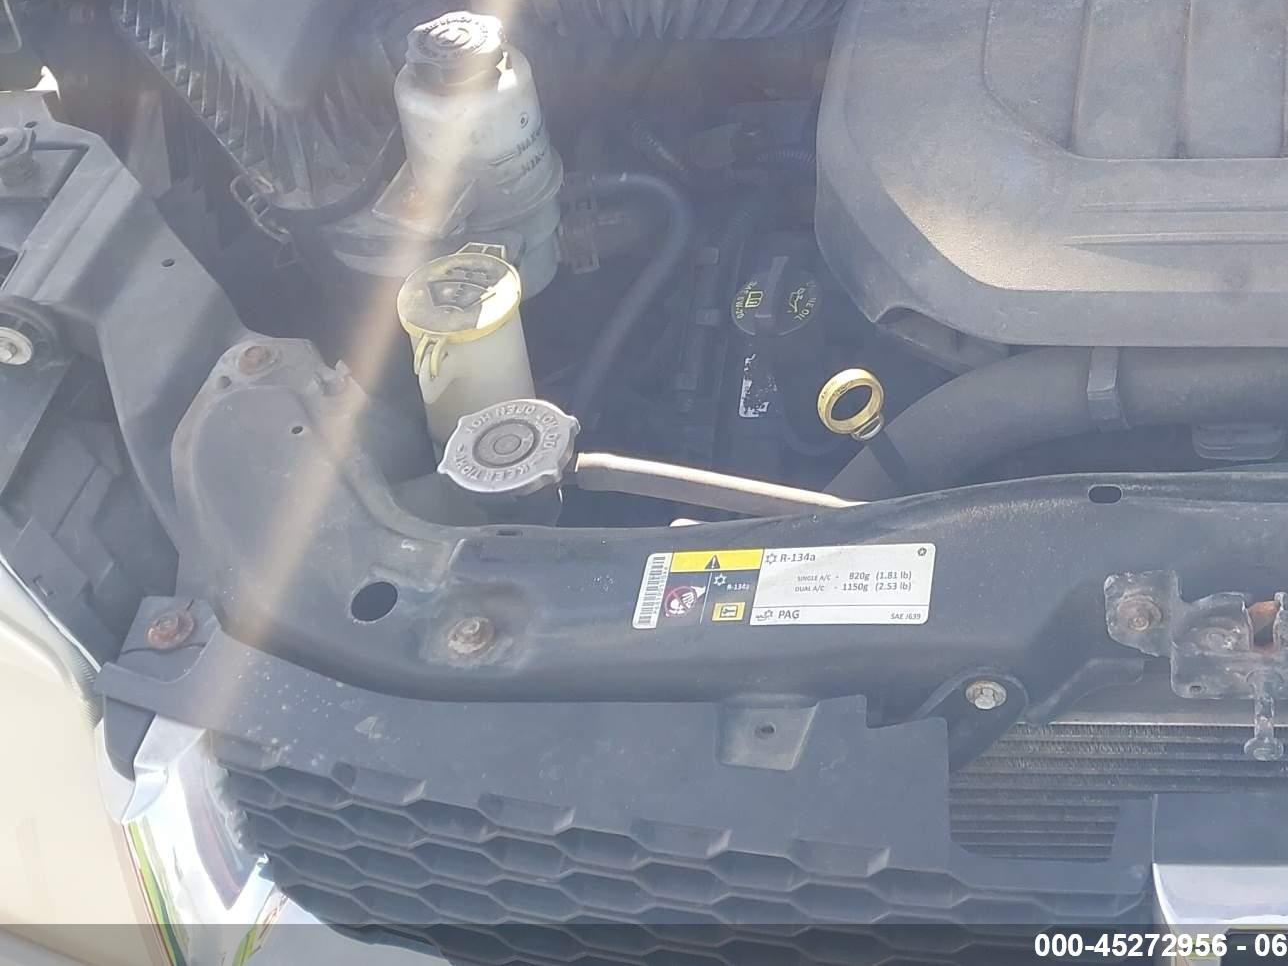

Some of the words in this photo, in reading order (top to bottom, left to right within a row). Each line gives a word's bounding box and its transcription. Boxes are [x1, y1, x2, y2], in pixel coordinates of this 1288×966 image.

[779, 552, 816, 563] R-134a
[818, 573, 832, 582] A/C
[849, 572, 870, 582] 820g
[876, 571, 898, 581] (1.81
[900, 571, 912, 581] lb)
[795, 585, 812, 593] DUAL
[812, 584, 825, 593] A/C
[842, 583, 868, 593] 1150g
[875, 582, 898, 592] (2.53
[900, 582, 912, 592] lb)
[778, 610, 800, 620] PAG
[891, 612, 905, 620] SAE
[905, 612, 921, 620] J639
